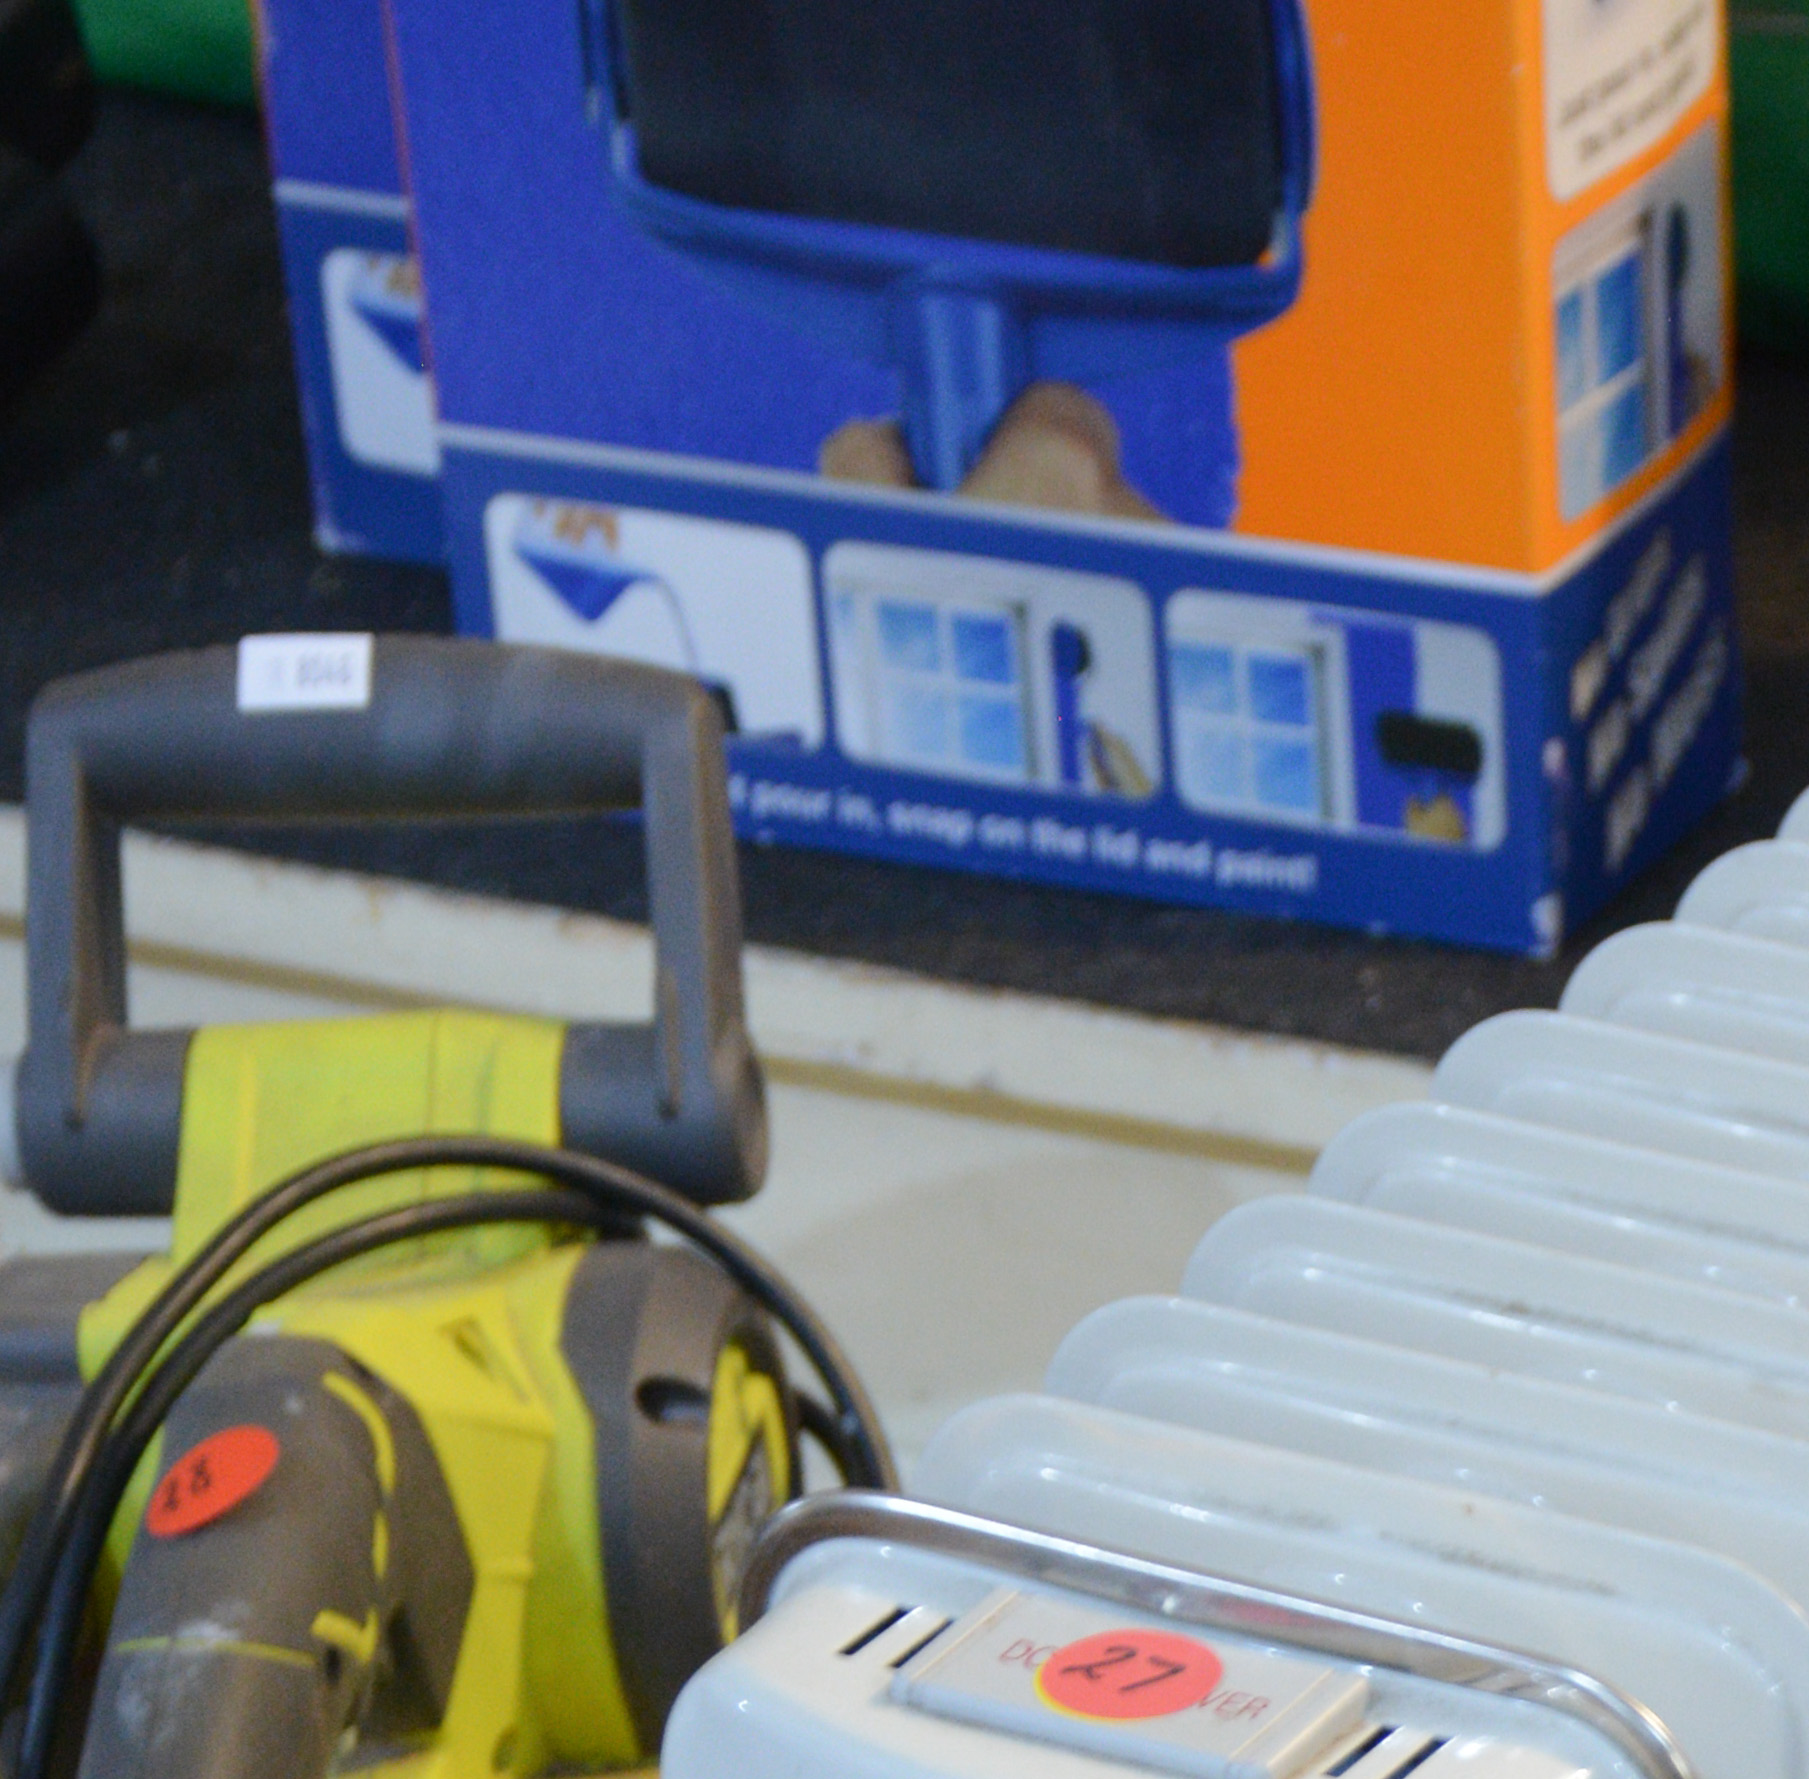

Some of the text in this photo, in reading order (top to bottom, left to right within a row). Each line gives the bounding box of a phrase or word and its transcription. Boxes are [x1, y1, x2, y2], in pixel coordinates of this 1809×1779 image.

[977, 813, 1026, 848] on
[1030, 817, 1088, 859] the
[1144, 837, 1213, 876] and
[1060, 1645, 1187, 1693] 27
